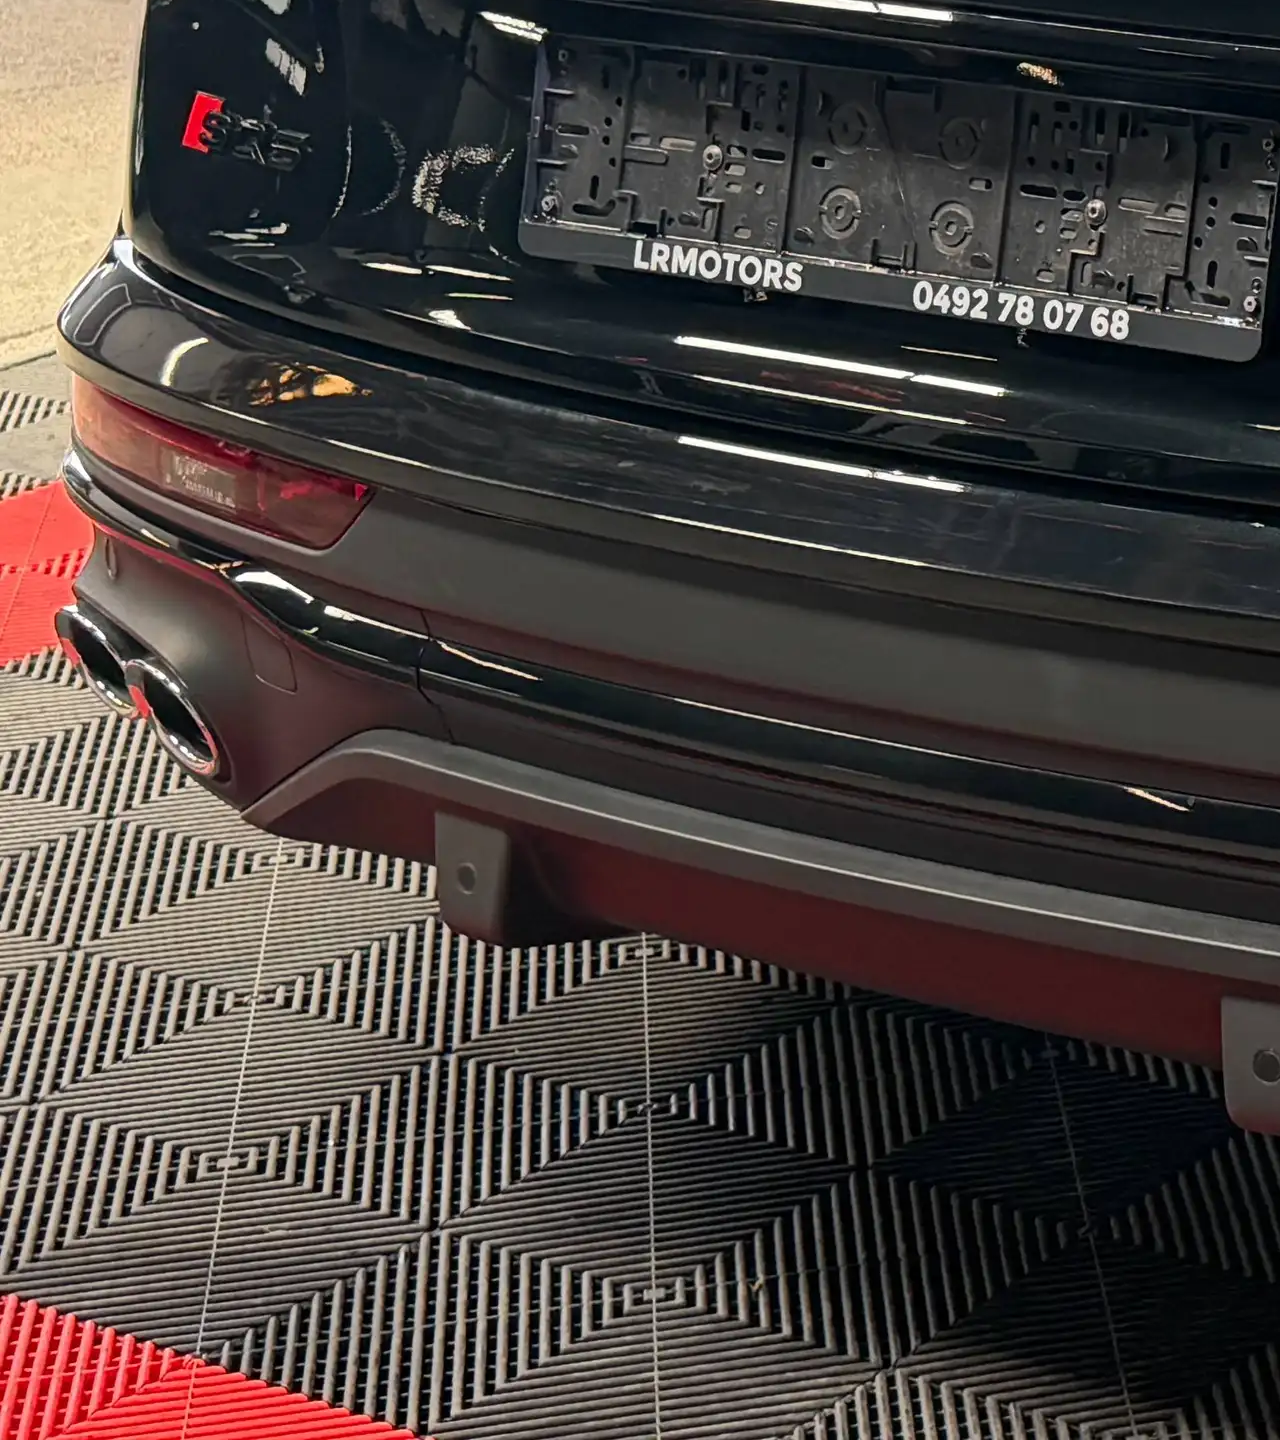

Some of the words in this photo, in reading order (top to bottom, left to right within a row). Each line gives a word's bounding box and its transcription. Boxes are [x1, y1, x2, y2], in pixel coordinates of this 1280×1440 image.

[633, 239, 804, 292] LRMOTORS
[912, 280, 989, 320] 0492
[997, 292, 1035, 326] 78
[1042, 299, 1085, 333] 07
[1090, 306, 1130, 341] 68
